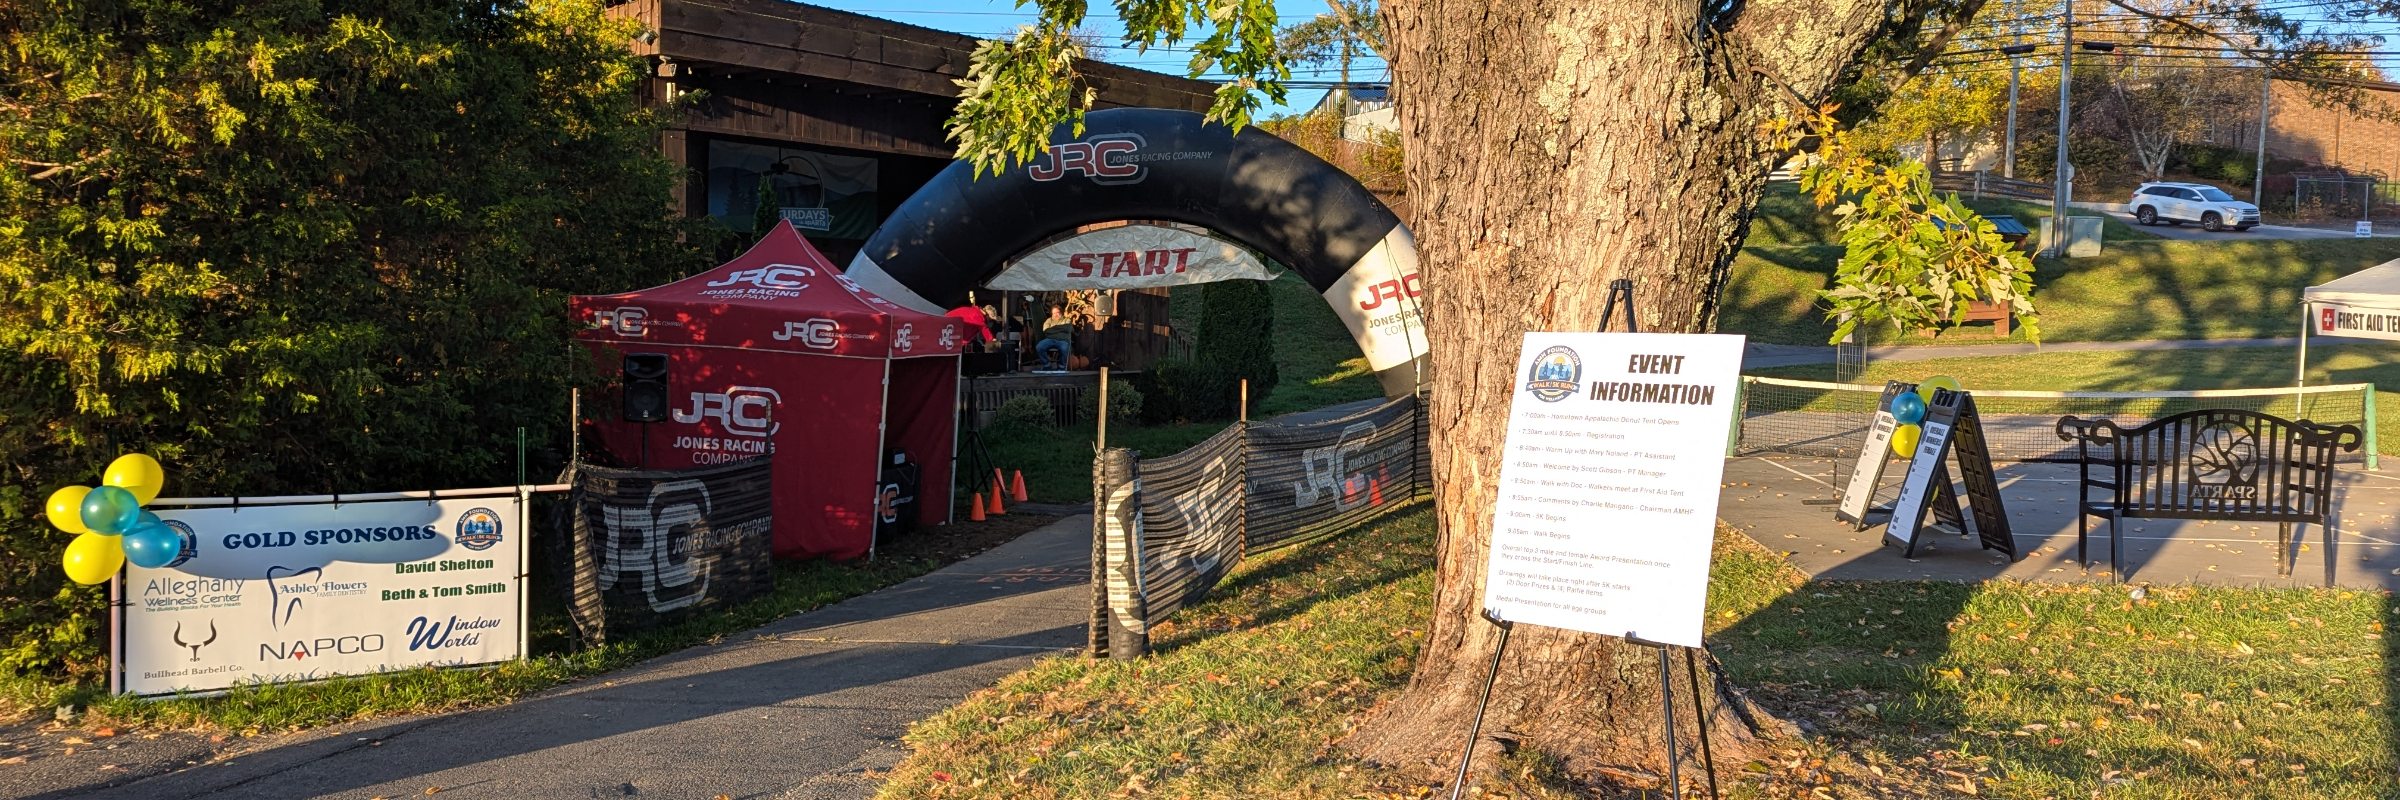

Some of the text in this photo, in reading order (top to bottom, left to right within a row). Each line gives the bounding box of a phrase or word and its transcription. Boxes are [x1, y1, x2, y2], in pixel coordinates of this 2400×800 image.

[1028, 138, 1139, 183] JRC
[1110, 151, 1213, 164] JONES RACING COMPANY
[1067, 248, 1196, 277] START
[707, 266, 808, 289] JRC
[697, 288, 800, 298] JONES RACING
[1369, 313, 1402, 328] JONES
[2337, 312, 2365, 331] FIRST
[2366, 314, 2383, 331] AID
[773, 320, 835, 344] JRC
[1628, 354, 1685, 374] EVENT
[1590, 381, 1715, 405] INFORMATION
[673, 390, 771, 429] JRC
[673, 436, 719, 450] JONES
[1543, 462, 1570, 471] Welcome
[1615, 485, 1631, 493] meet
[1538, 496, 1571, 505] Comments
[1639, 504, 1672, 513] Chairman
[223, 525, 436, 549] GOLD SPONSORS
[673, 529, 704, 555] JONES
[705, 524, 737, 548] RACING
[1549, 531, 1571, 540] Begins
[396, 559, 494, 574] David Shelton
[1611, 555, 1653, 566] Presentation
[1654, 560, 1671, 568] once
[143, 575, 246, 598] Alleghany
[279, 581, 368, 595] Ashley Flowers
[381, 582, 506, 601] Beth & Tom Smith
[144, 594, 243, 607] Wellness Center
[1583, 607, 1607, 616] groups
[260, 634, 384, 661] NAPCO
[144, 669, 188, 680] Bullhead
[191, 665, 226, 675] Barbell
